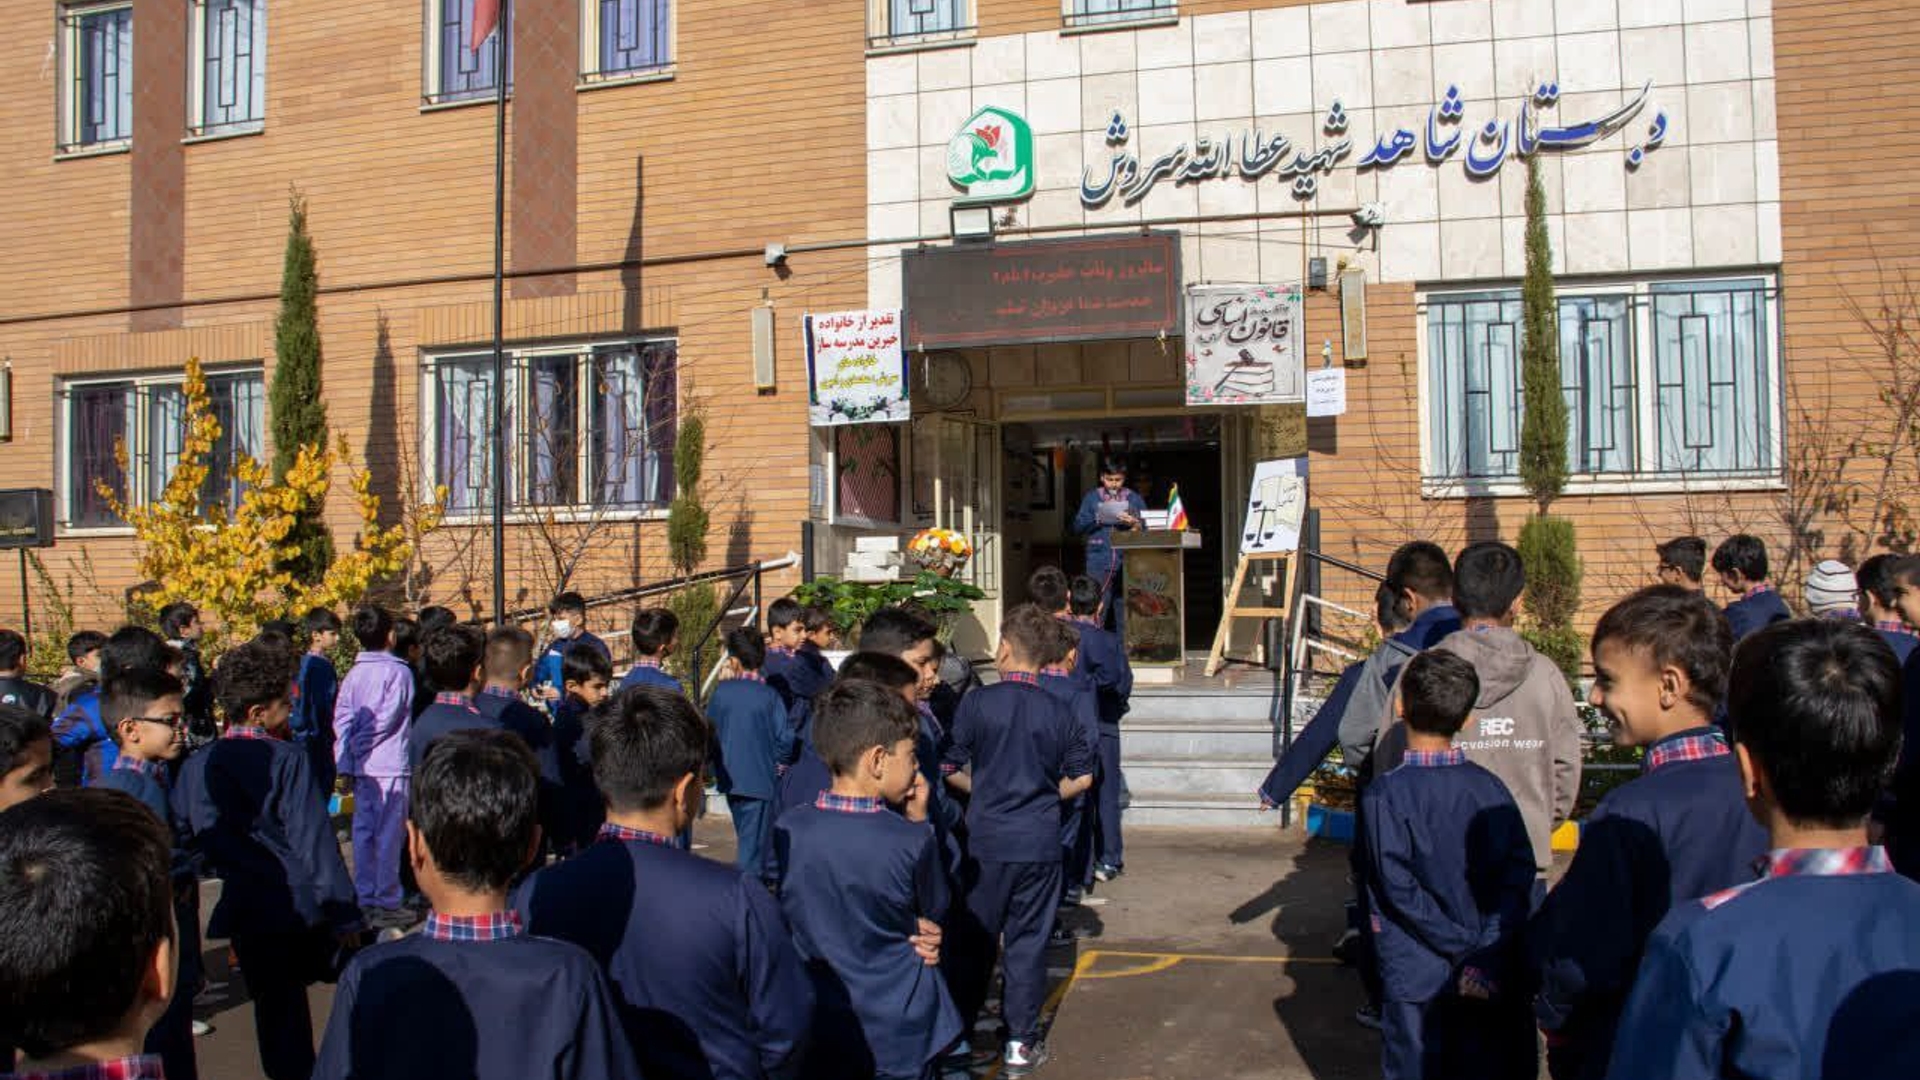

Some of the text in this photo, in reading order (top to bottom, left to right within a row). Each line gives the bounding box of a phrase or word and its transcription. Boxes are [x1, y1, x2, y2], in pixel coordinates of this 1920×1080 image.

[1283, 101, 1352, 201] شهید
[1357, 83, 1464, 168] شاهد
[1465, 80, 1668, 178] دبستان
[1080, 109, 1186, 206] سروش
[819, 313, 894, 333] تقدیر از خانواده
[1197, 297, 1248, 326] اساسی
[1228, 317, 1290, 344] قانون
[817, 332, 898, 354] خیرین مدرسه ساز
